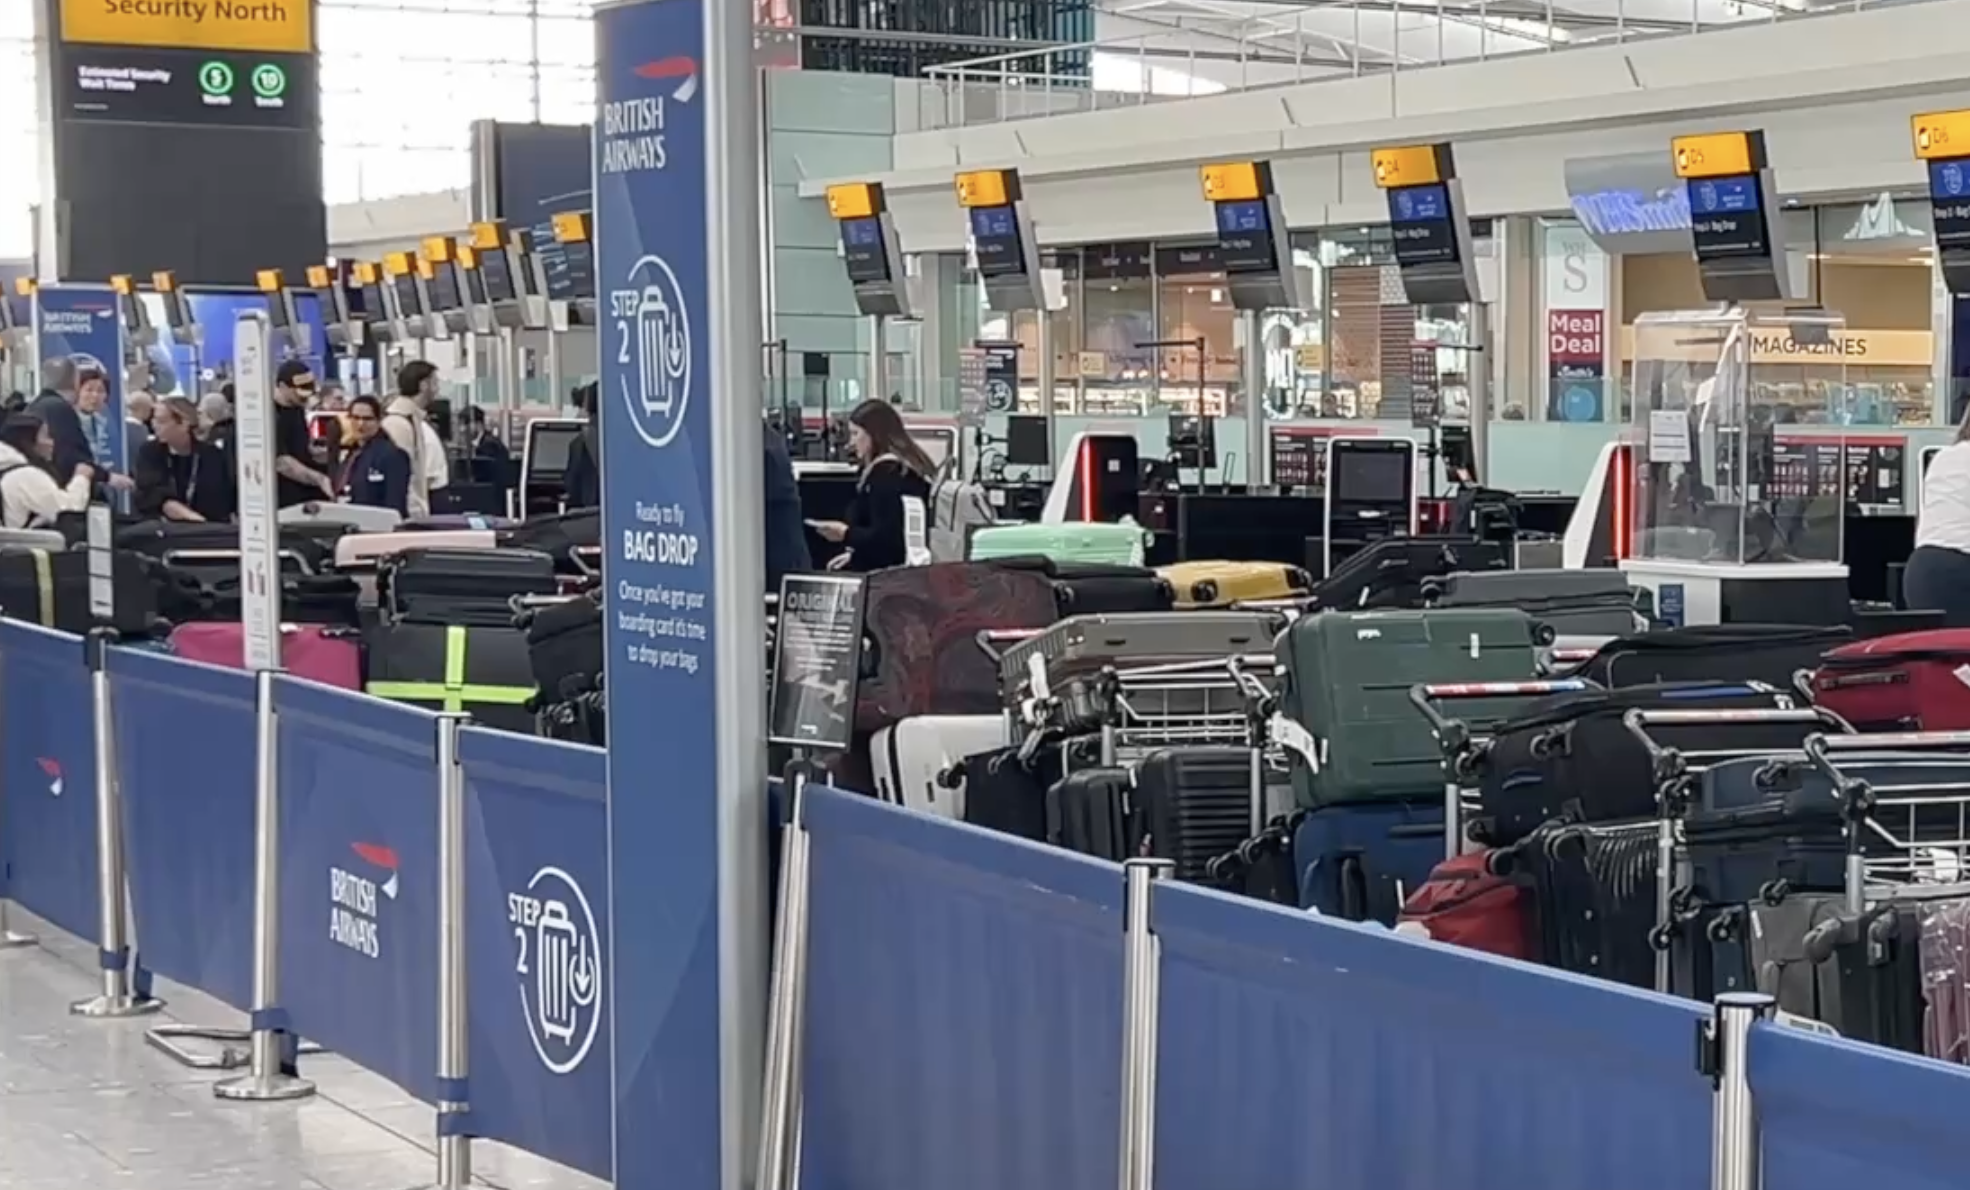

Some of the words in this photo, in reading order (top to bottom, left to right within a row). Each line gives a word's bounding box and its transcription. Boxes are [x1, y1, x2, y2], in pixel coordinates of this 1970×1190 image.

[105, 0, 208, 23] Security
[214, 0, 288, 22] North
[603, 95, 664, 135] BRITISH
[601, 134, 666, 174] AIRWAYS
[1564, 253, 1588, 293] S
[611, 290, 640, 317] STEP
[1551, 313, 1600, 333] Meal
[617, 320, 630, 363] 2
[1551, 334, 1600, 354] Deal
[1753, 336, 1867, 355] MAGAZINES
[636, 501, 661, 526] Ready
[662, 506, 672, 524] to
[673, 503, 685, 527] fly
[623, 529, 656, 563] BAG
[657, 531, 698, 566] DROP
[618, 580, 643, 601] Once
[686, 593, 705, 610] your
[618, 610, 656, 639] boarding
[656, 617, 675, 636] card
[627, 645, 638, 662] to
[638, 644, 658, 668] drop
[658, 650, 678, 669] your
[678, 649, 698, 674] bags
[329, 866, 376, 917] BRITISH
[508, 892, 541, 926] STEP
[329, 907, 379, 958] AIRWAYS
[514, 926, 528, 974] 2
